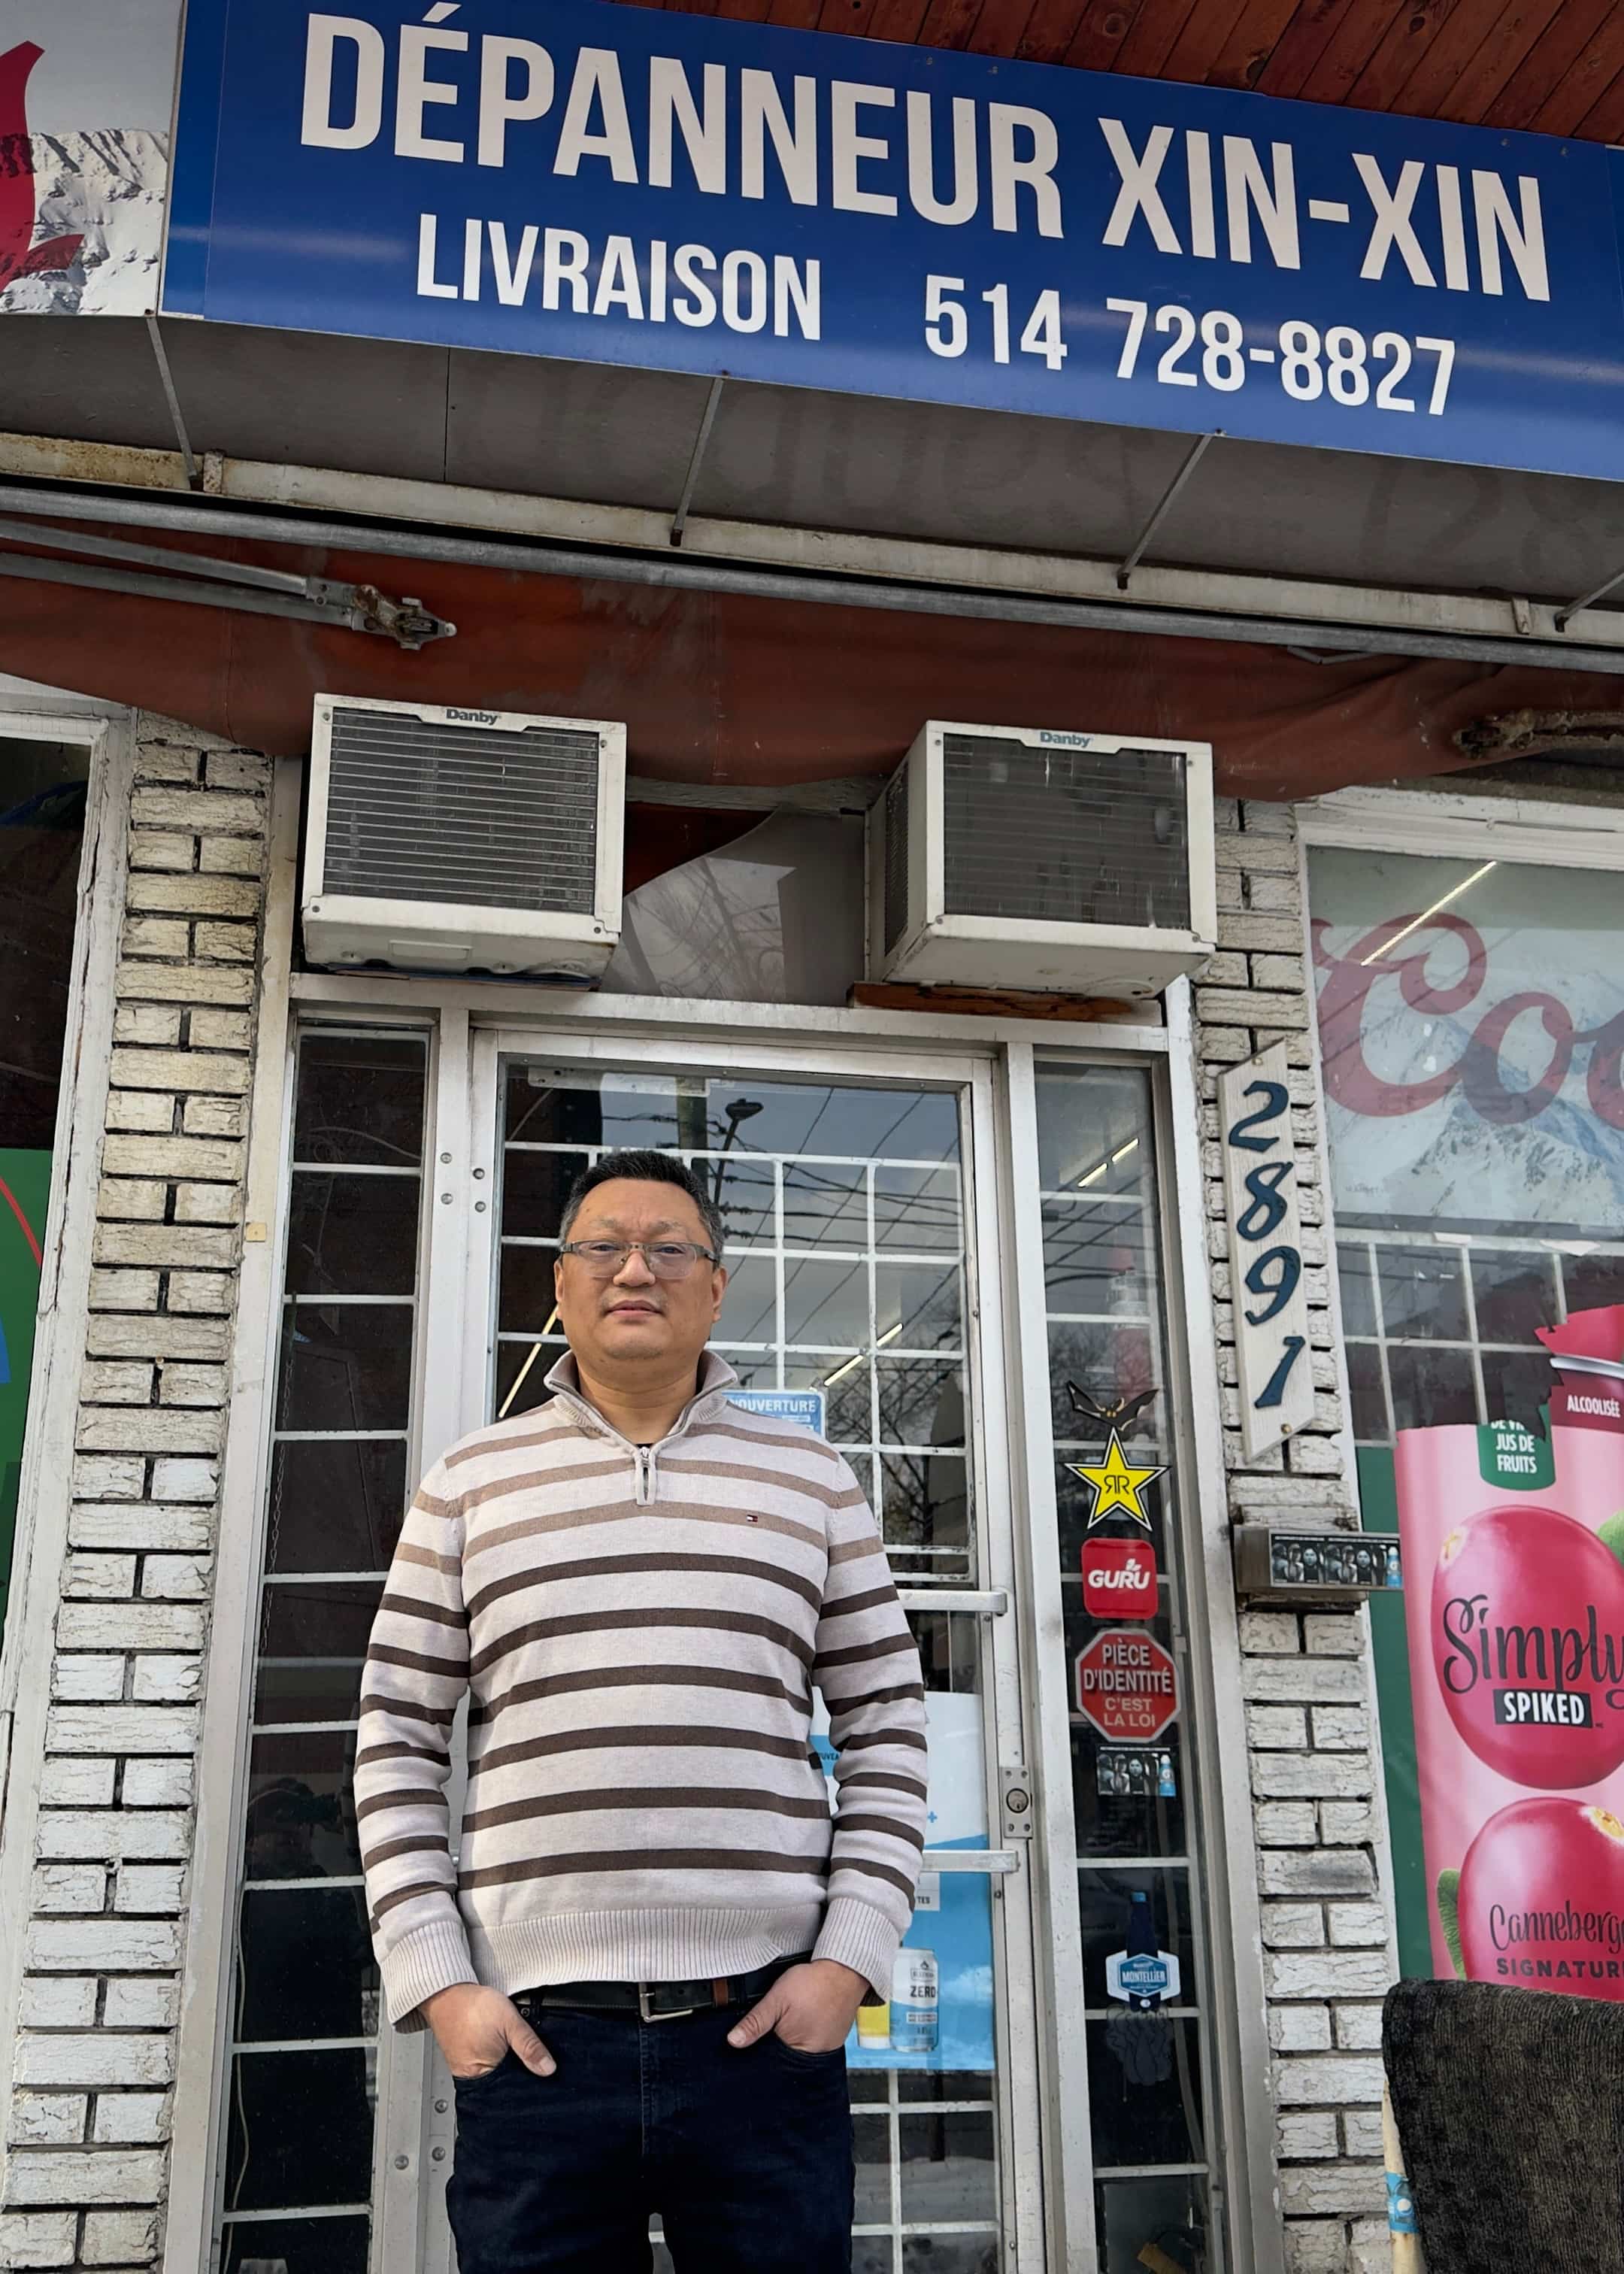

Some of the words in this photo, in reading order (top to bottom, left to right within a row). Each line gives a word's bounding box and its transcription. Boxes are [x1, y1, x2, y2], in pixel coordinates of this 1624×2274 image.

[301, 2, 1064, 239] DÉPANNEUR
[1098, 118, 1550, 301] XIN-XIN
[417, 214, 820, 341] LIVRAISON
[925, 274, 1067, 370] 514
[1106, 298, 1456, 415] 728-8827
[447, 709, 497, 725] Danby
[1041, 731, 1090, 747] Danby
[1229, 1081, 1306, 1408] 2891
[1567, 1394, 1621, 1417] ALCOOLISÉE
[1496, 1433, 1517, 1451] JUS
[1518, 1434, 1535, 1453] DE
[1497, 1454, 1537, 1474] FRUITS
[1088, 1569, 1150, 1589] GURU
[1102, 1637, 1151, 1666] PIÈCE
[1083, 1666, 1172, 1693] D'IDENTITÉ
[1104, 1696, 1152, 1712] C'EST
[1504, 1691, 1585, 1724] SPIKED
[1104, 1713, 1125, 1727] LA
[1129, 1714, 1156, 1727] LOI
[1489, 1900, 1624, 1955] Canneberg
[1496, 1957, 1624, 1978] SIGNATUR
[910, 1985, 936, 1998] ZERO
